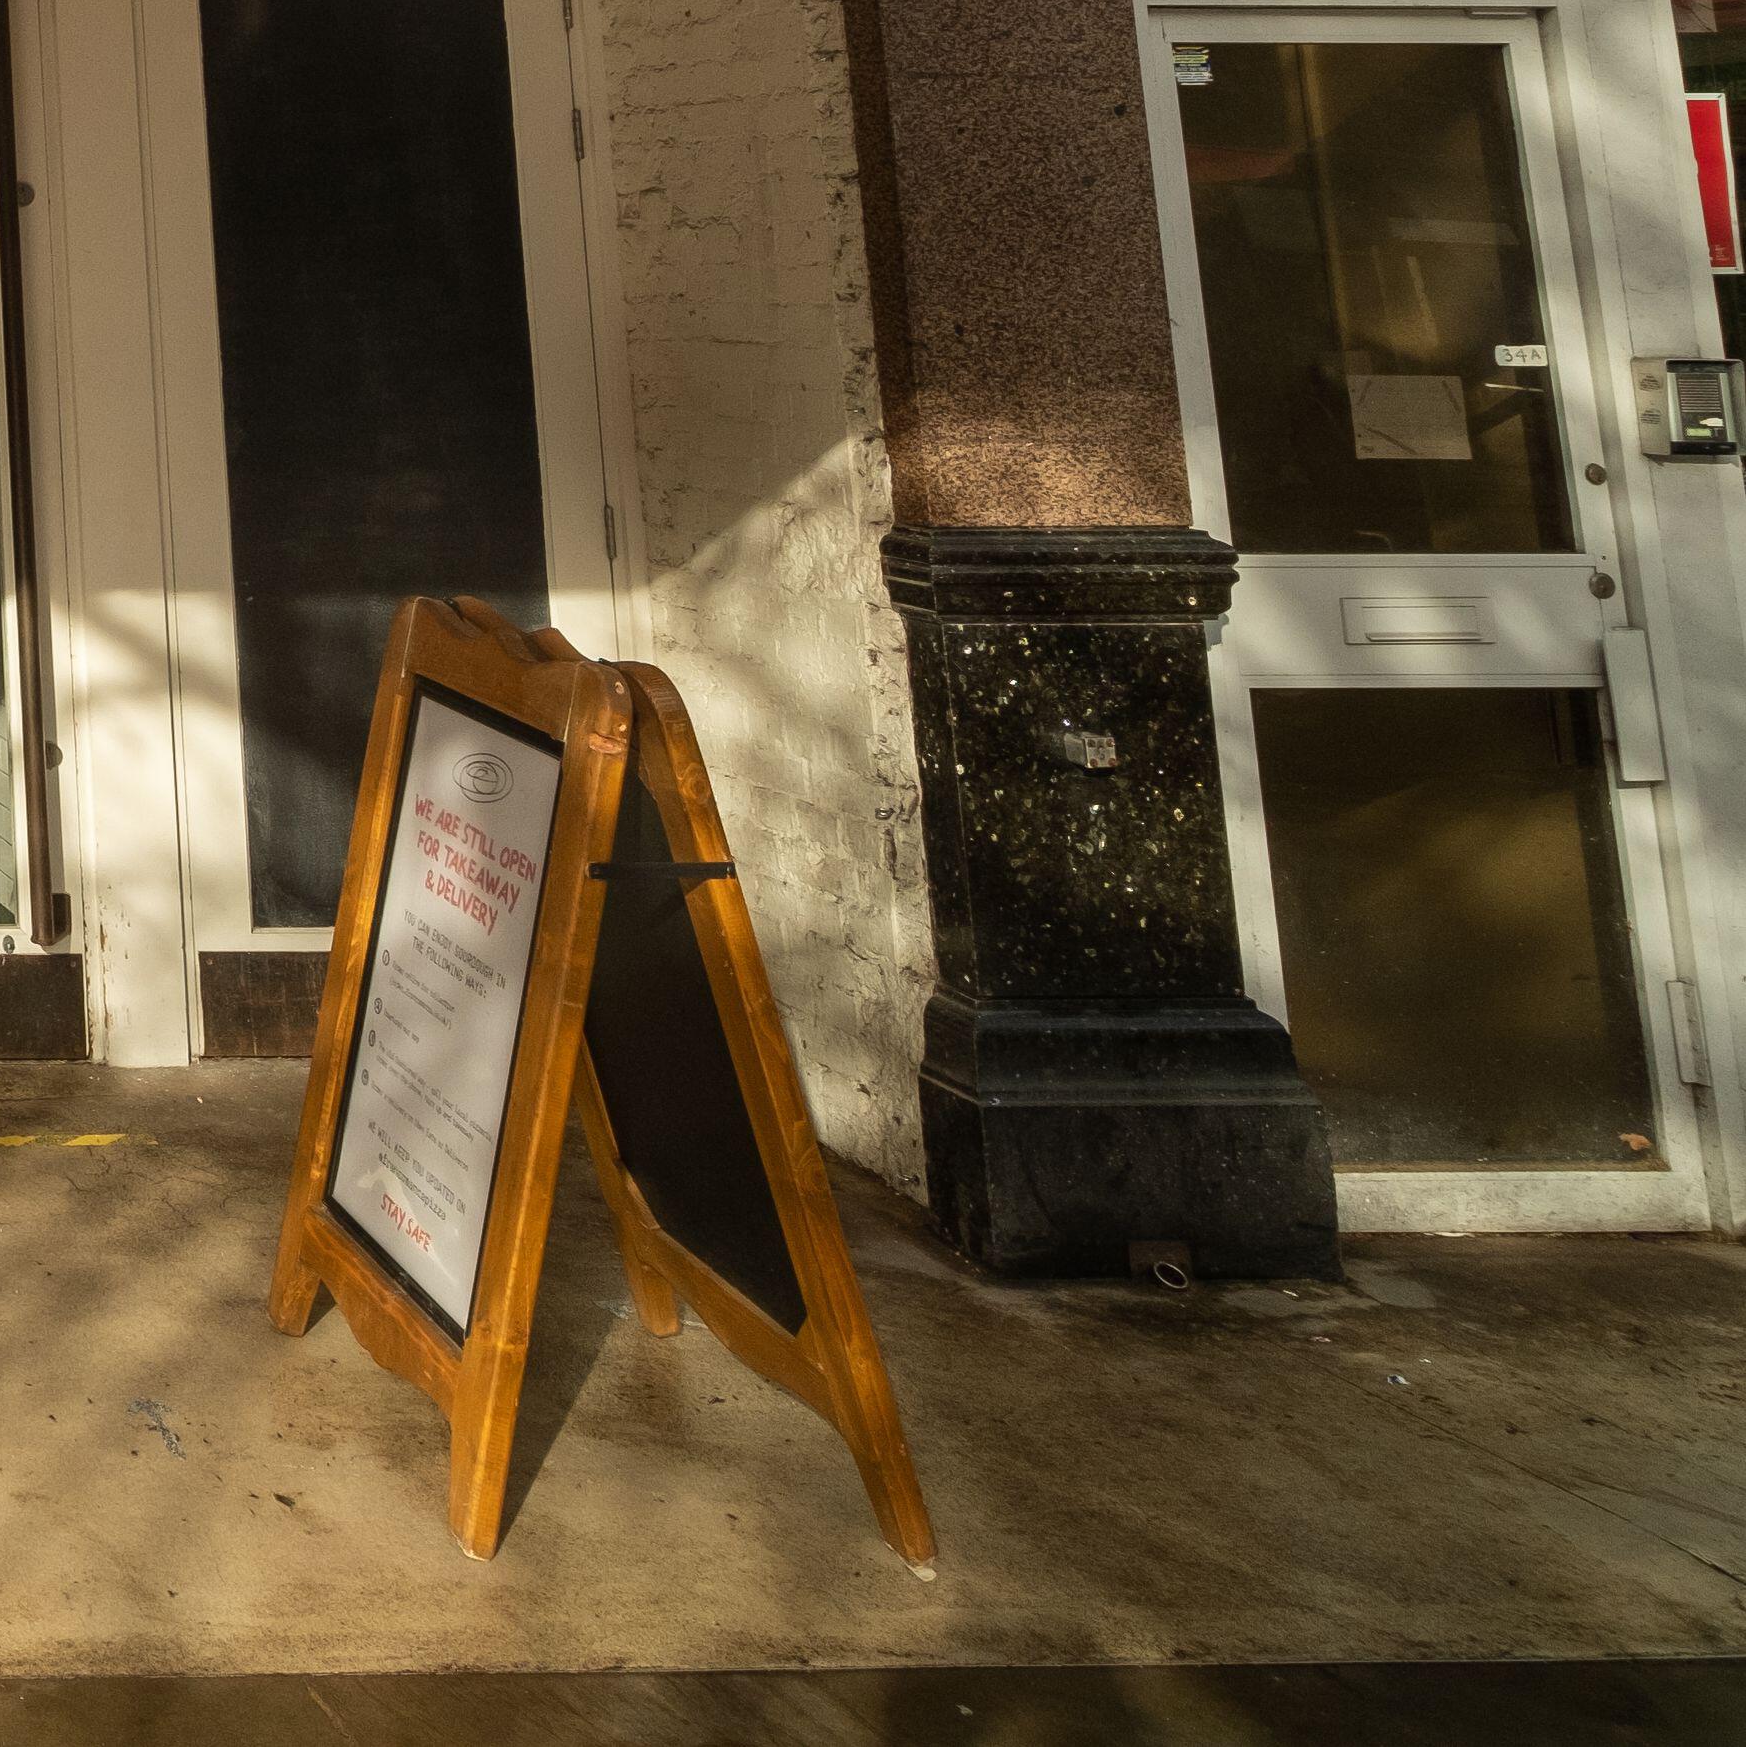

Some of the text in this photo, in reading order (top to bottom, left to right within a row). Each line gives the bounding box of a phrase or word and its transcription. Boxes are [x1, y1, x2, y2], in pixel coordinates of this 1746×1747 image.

[413, 793, 537, 885] WE ARE STILL OPEN
[416, 829, 520, 916] FOR TAKEAWAY
[424, 867, 498, 938] & DELIVERY
[411, 934, 424, 955] THE
[425, 944, 463, 982] FOLLOWING
[417, 918, 430, 938] CAN
[431, 927, 452, 952] ENJOY
[453, 943, 493, 982] SOURDOUGH
[495, 971, 506, 990] IN
[379, 1190, 431, 1255] STAY SAFE
